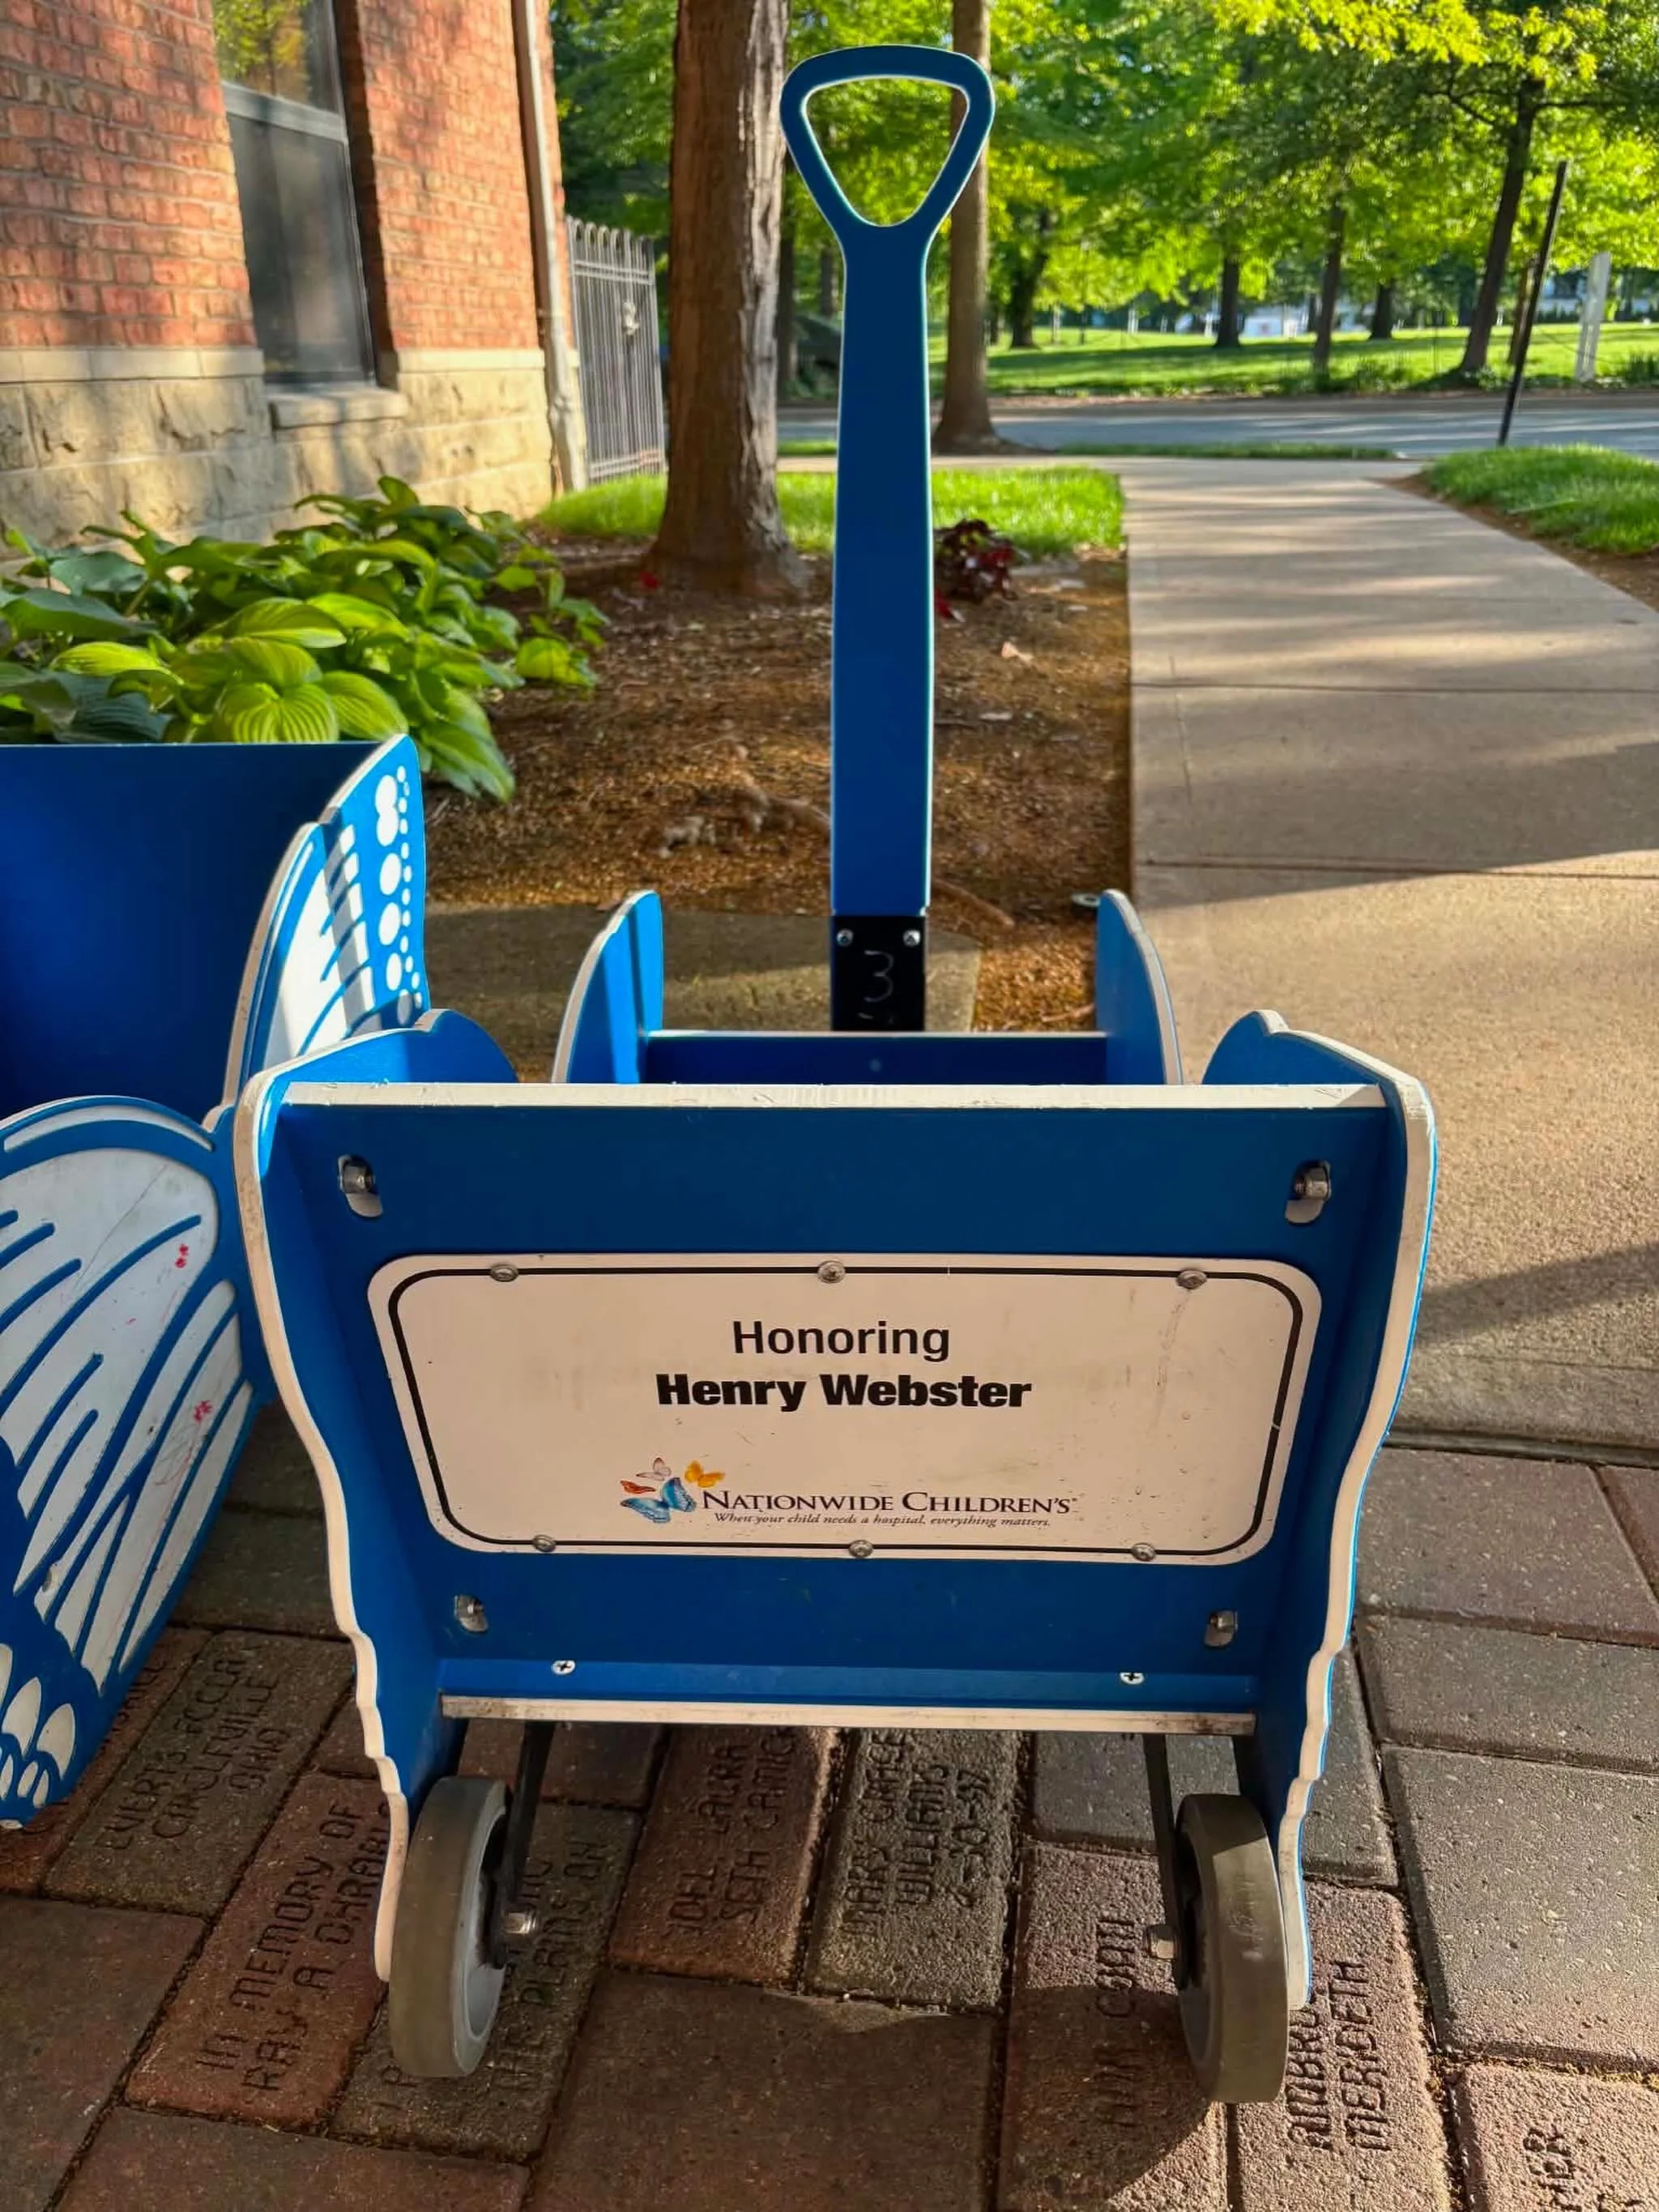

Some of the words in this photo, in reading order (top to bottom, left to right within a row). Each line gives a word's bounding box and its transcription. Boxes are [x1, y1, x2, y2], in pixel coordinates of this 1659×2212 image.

[733, 1320, 949, 1362] Honoring
[655, 1373, 807, 1413] Henry
[819, 1374, 1033, 1408] Webster
[702, 1490, 894, 1511] NATIONWIDE
[714, 1512, 753, 1523] When
[753, 1514, 784, 1525] your
[787, 1513, 820, 1524] child
[823, 1513, 857, 1524] needs
[930, 1515, 997, 1528] everything
[1000, 1517, 1051, 1528] matters.
[228, 1728, 292, 1791] OHIO
[224, 1856, 335, 2010] MEMORY
[315, 1802, 362, 1839] OF
